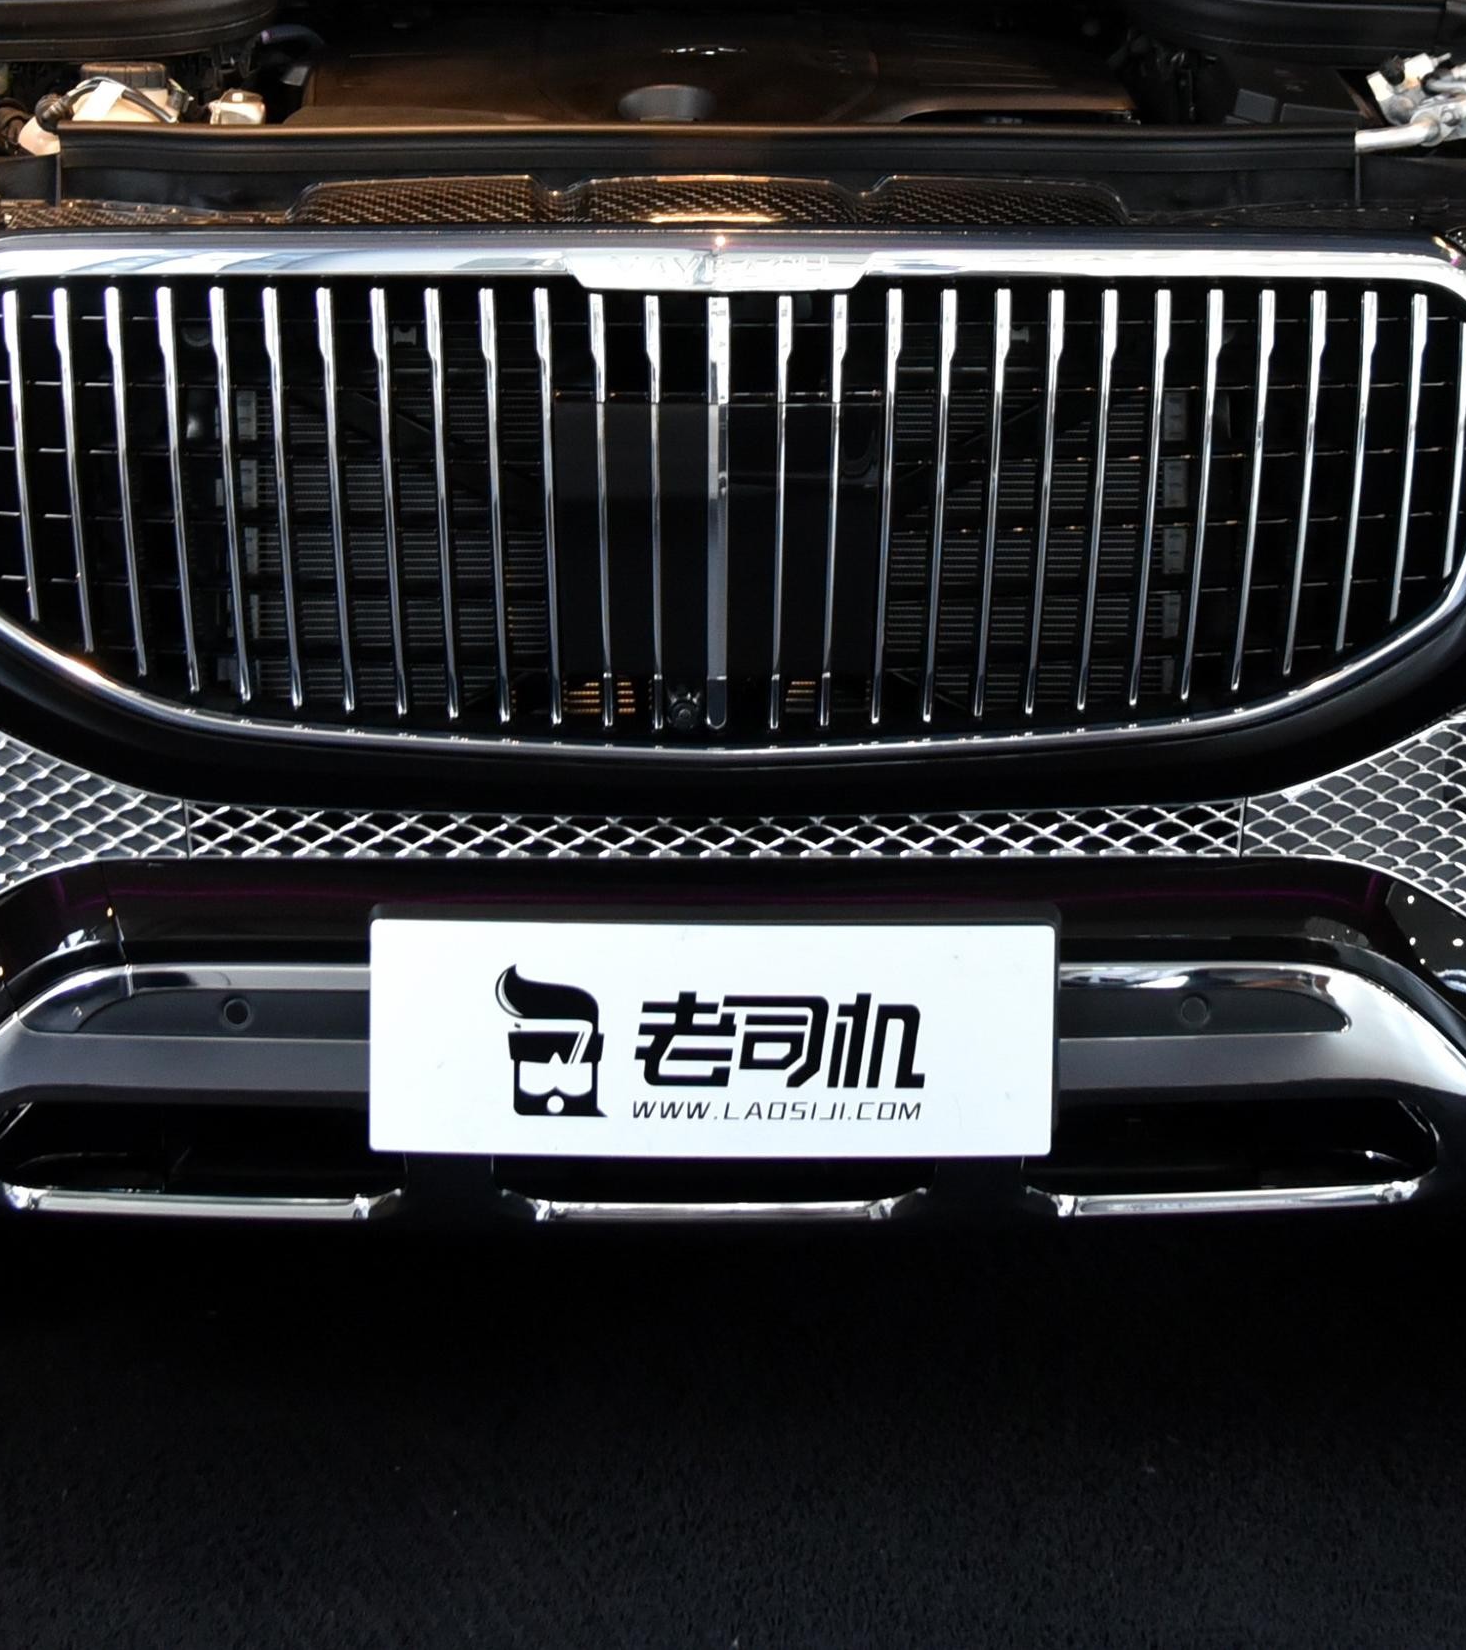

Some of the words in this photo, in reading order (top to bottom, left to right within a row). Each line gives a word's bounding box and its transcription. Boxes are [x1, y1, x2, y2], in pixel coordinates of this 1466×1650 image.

[635, 990, 925, 1089] 老司机
[632, 1100, 923, 1121] WWW.LAOSIJI.COM
